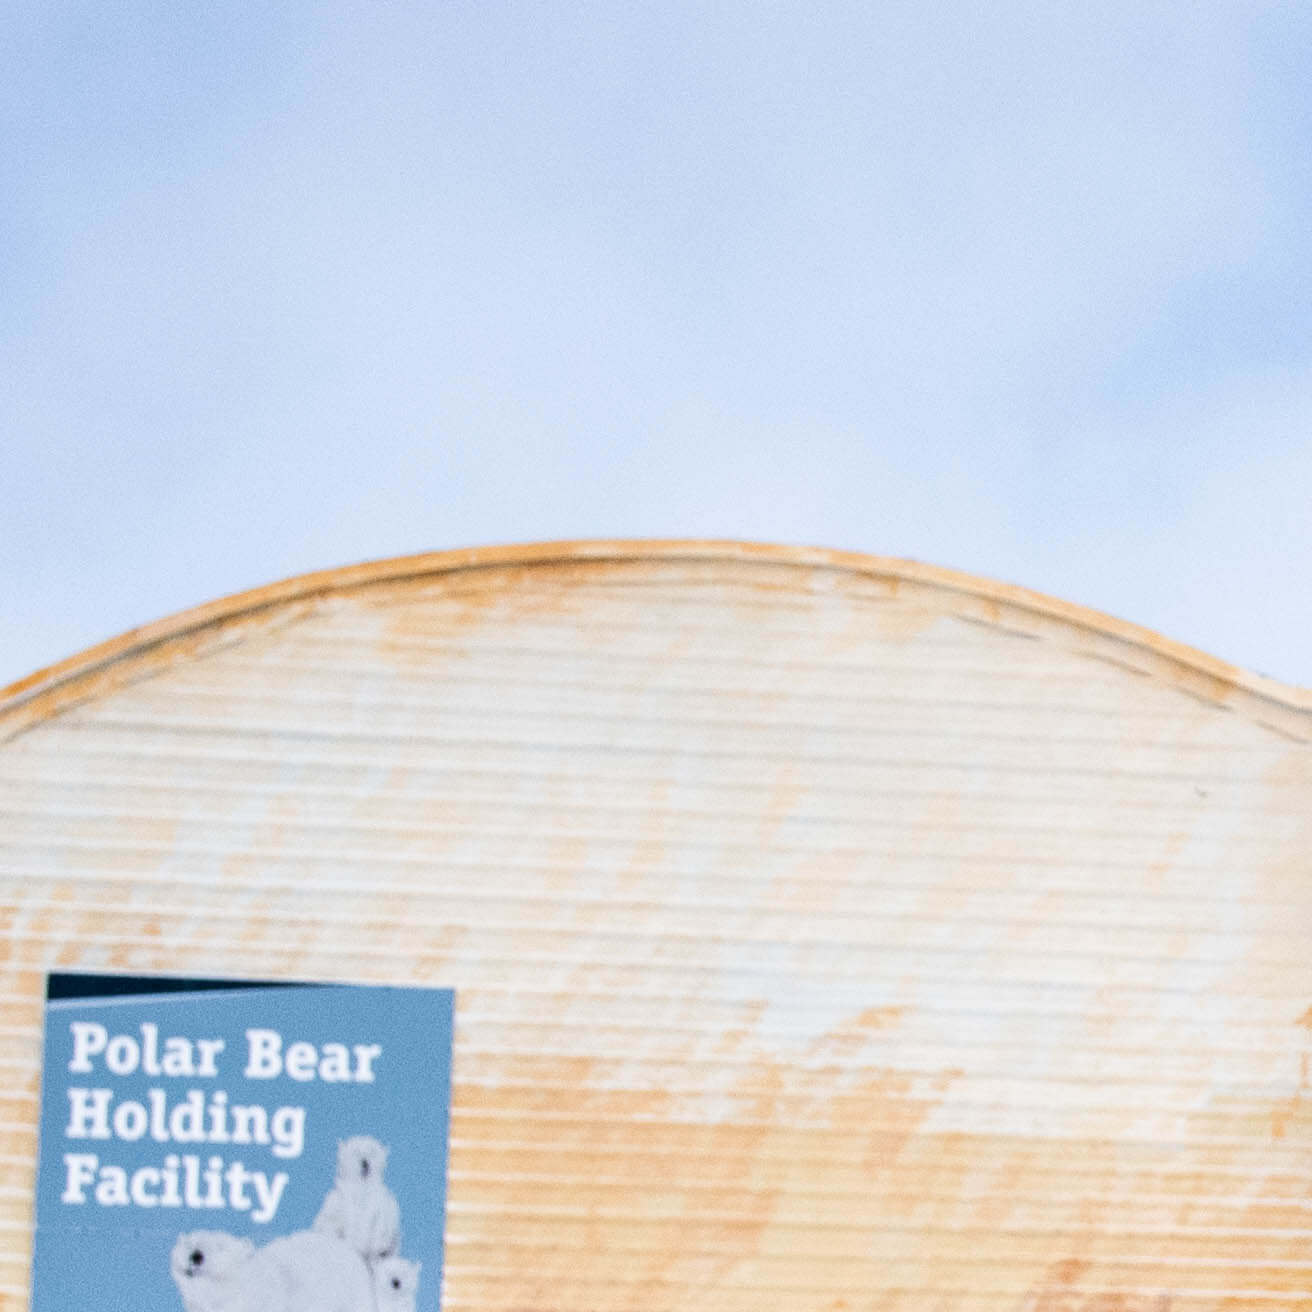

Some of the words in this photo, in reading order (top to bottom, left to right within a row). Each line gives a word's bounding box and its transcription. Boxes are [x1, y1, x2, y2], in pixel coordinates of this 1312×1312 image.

[69, 1021, 225, 1077] Polar
[244, 1028, 382, 1083] Bear
[65, 1088, 306, 1159] Holding
[61, 1154, 290, 1224] Facility
